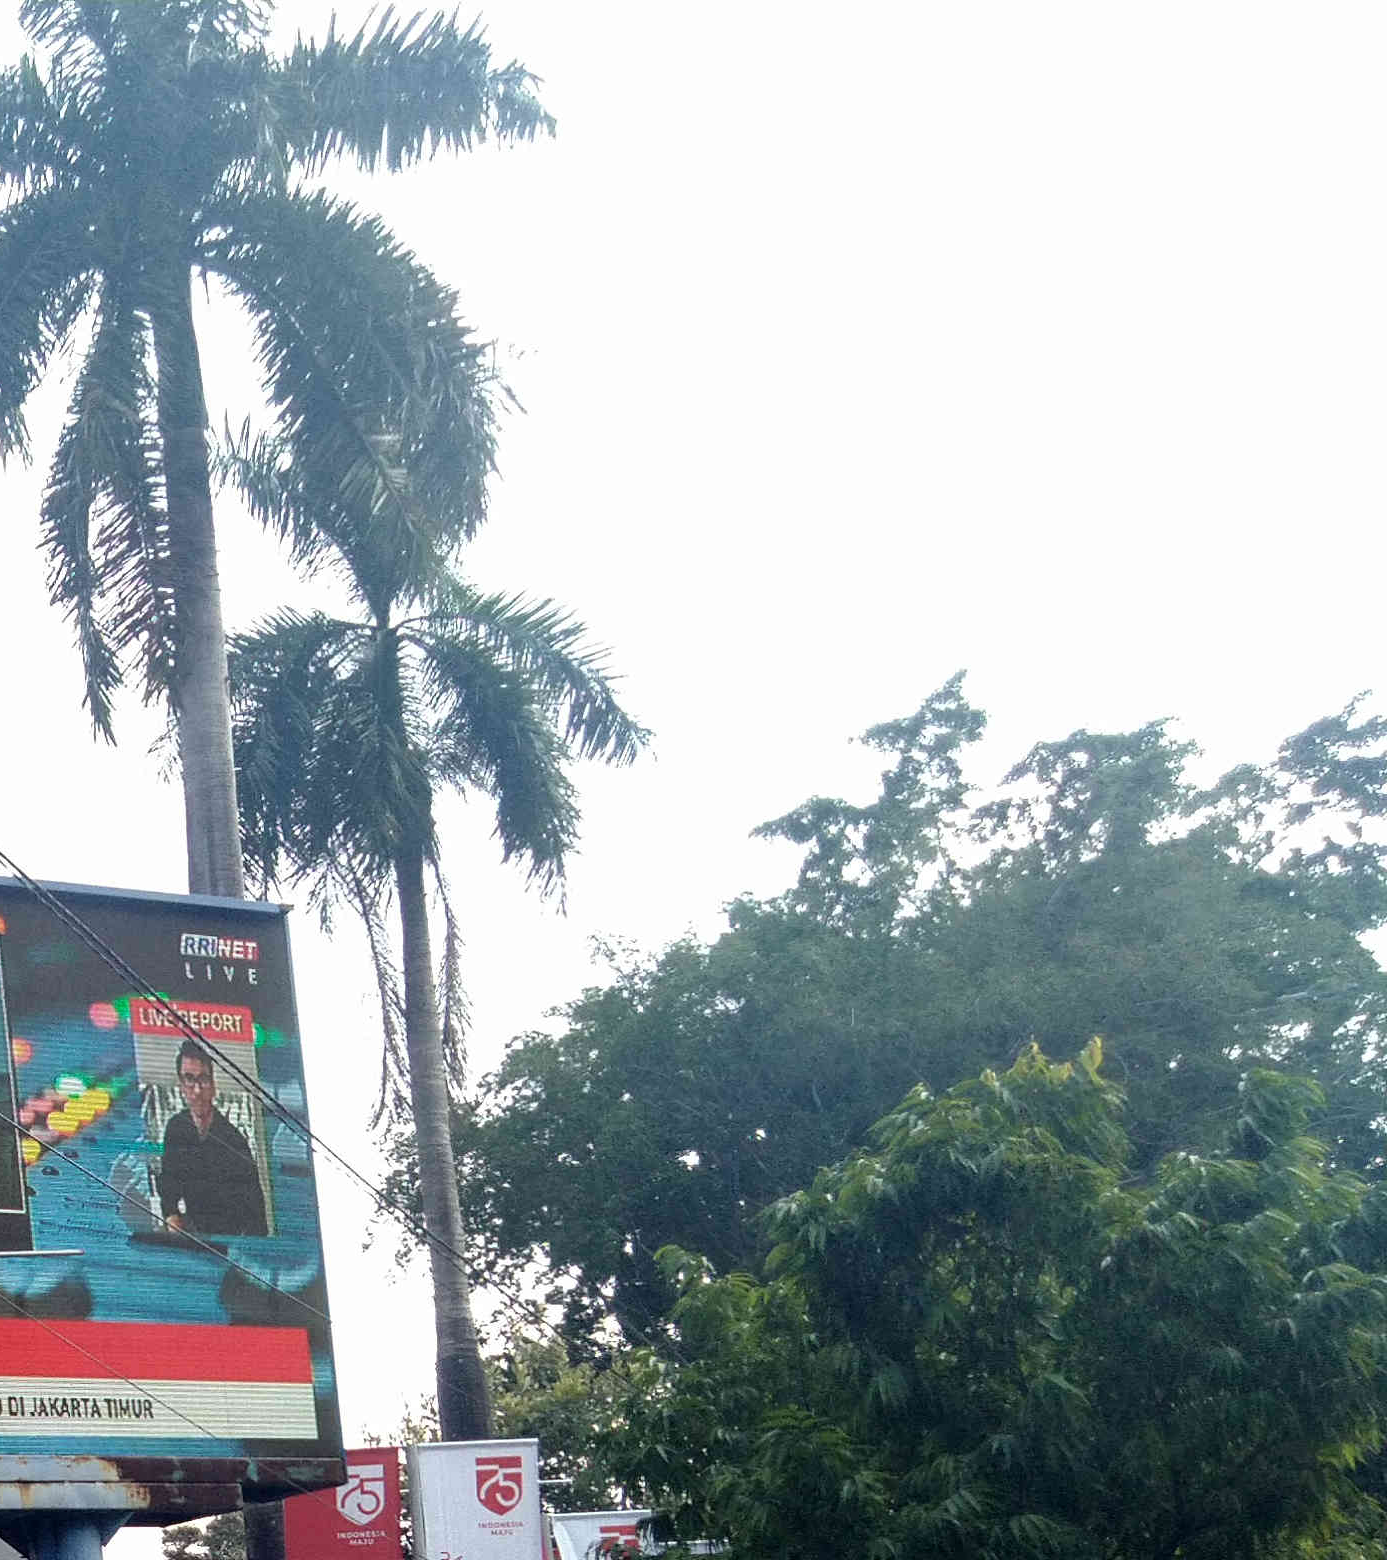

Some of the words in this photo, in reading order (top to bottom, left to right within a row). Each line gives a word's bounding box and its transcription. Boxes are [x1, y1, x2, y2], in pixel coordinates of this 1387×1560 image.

[184, 962, 258, 985] LIVE
[139, 1008, 176, 1027] LIVE
[8, 1397, 25, 1417] DI
[29, 1396, 102, 1419] JAKARTA
[103, 1397, 154, 1420] TIMUR
